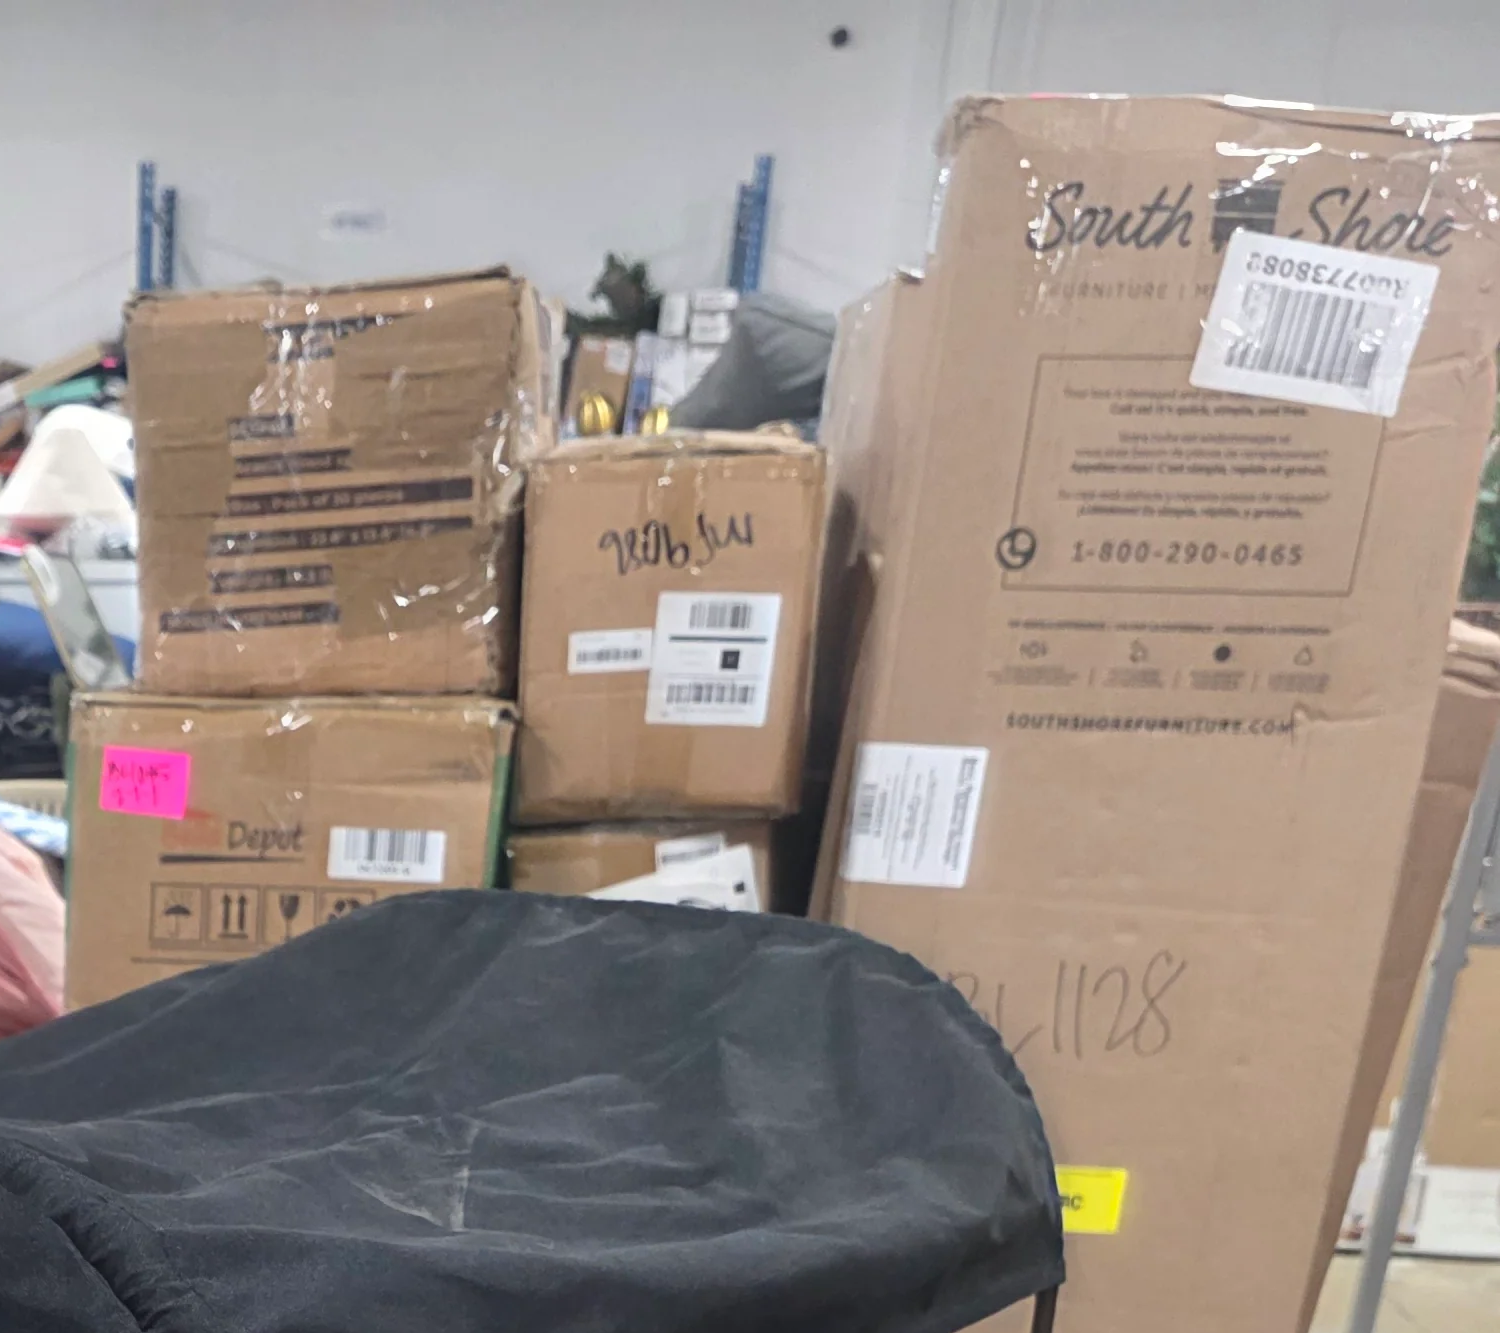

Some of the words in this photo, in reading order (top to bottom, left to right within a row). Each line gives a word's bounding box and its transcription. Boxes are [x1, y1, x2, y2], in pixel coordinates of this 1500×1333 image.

[1025, 181, 1194, 252] South
[1289, 186, 1457, 257] Shore
[1071, 540, 1303, 567] 1-800-290-0465
[227, 820, 304, 858] Depot
